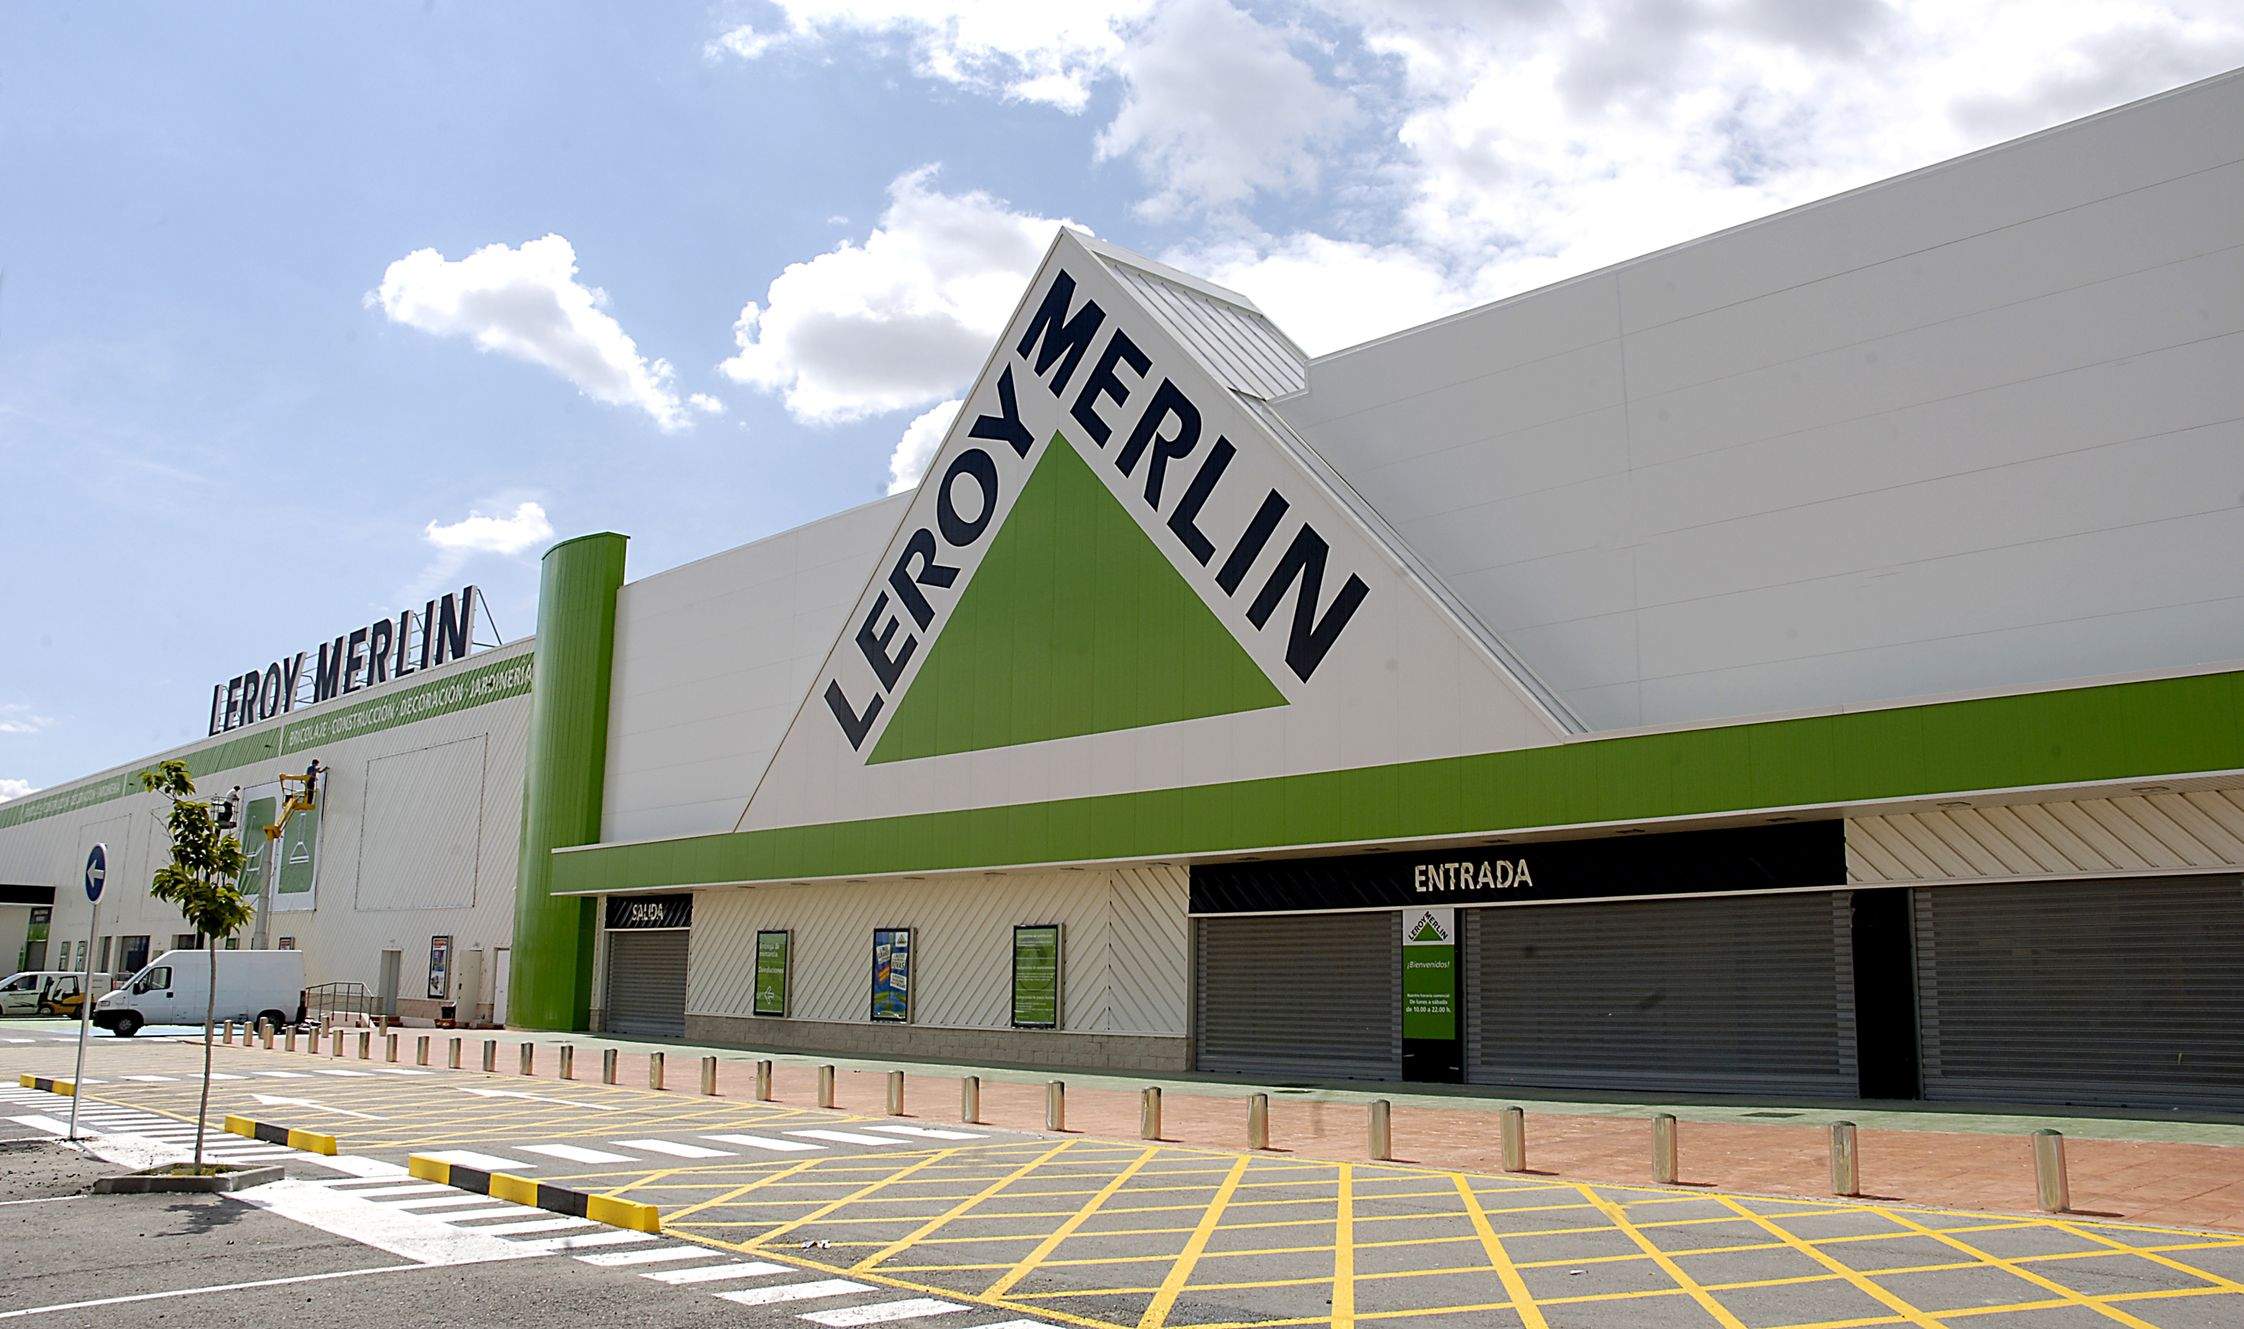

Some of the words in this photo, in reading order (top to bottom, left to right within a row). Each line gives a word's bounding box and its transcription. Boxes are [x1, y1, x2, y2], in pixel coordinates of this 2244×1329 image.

[823, 361, 1035, 753] LEROY
[1016, 267, 1371, 685] MERLIN
[208, 651, 307, 737] LEROY
[313, 585, 477, 703] MERLIN
[330, 700, 395, 735] CONSTRUCCIÓN
[1414, 858, 1533, 893] ENTRADA
[631, 903, 664, 921] SALIDA
[1407, 916, 1427, 941] LEROY
[1424, 910, 1448, 940] MERLIN
[1406, 960, 1450, 970] ¡Bienvenidos!
